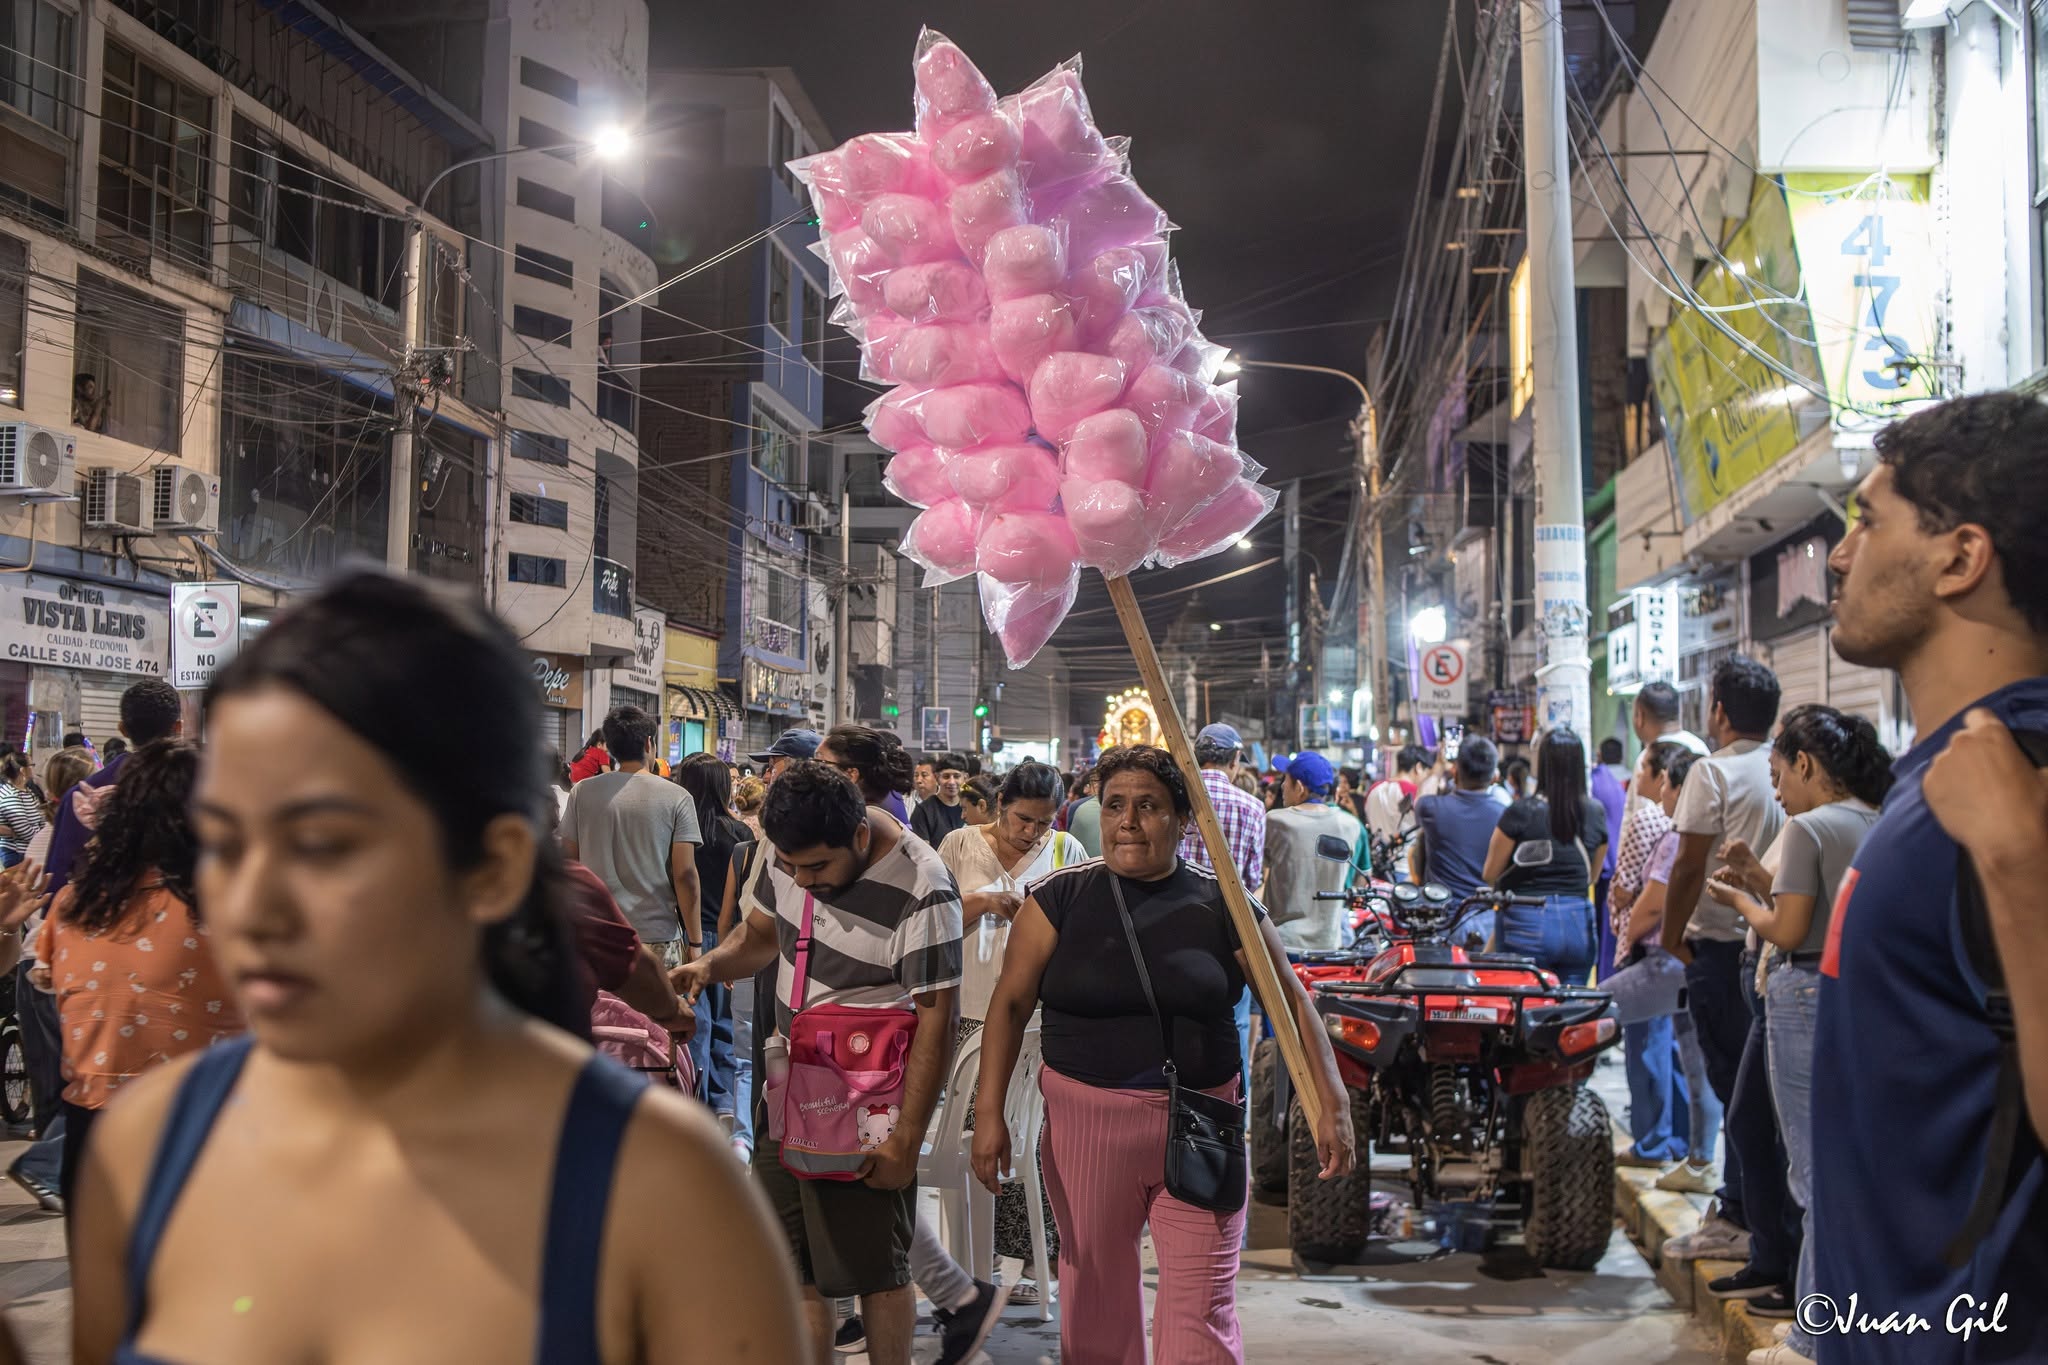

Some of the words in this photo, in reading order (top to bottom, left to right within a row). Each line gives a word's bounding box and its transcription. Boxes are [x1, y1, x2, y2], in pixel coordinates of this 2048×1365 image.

[1841, 215, 1911, 390] 473
[23, 597, 87, 632] VISTA
[93, 608, 146, 640] LENS
[47, 633, 83, 649] CALIDAD
[90, 638, 129, 653] ECONOMIA
[8, 643, 58, 662] CALLE
[62, 651, 92, 665] SAN
[96, 655, 132, 670] JOSE
[135, 659, 159, 674] 474
[197, 654, 216, 667] NO
[180, 670, 217, 681] ESTACIO
[812, 914, 827, 928] RIS
